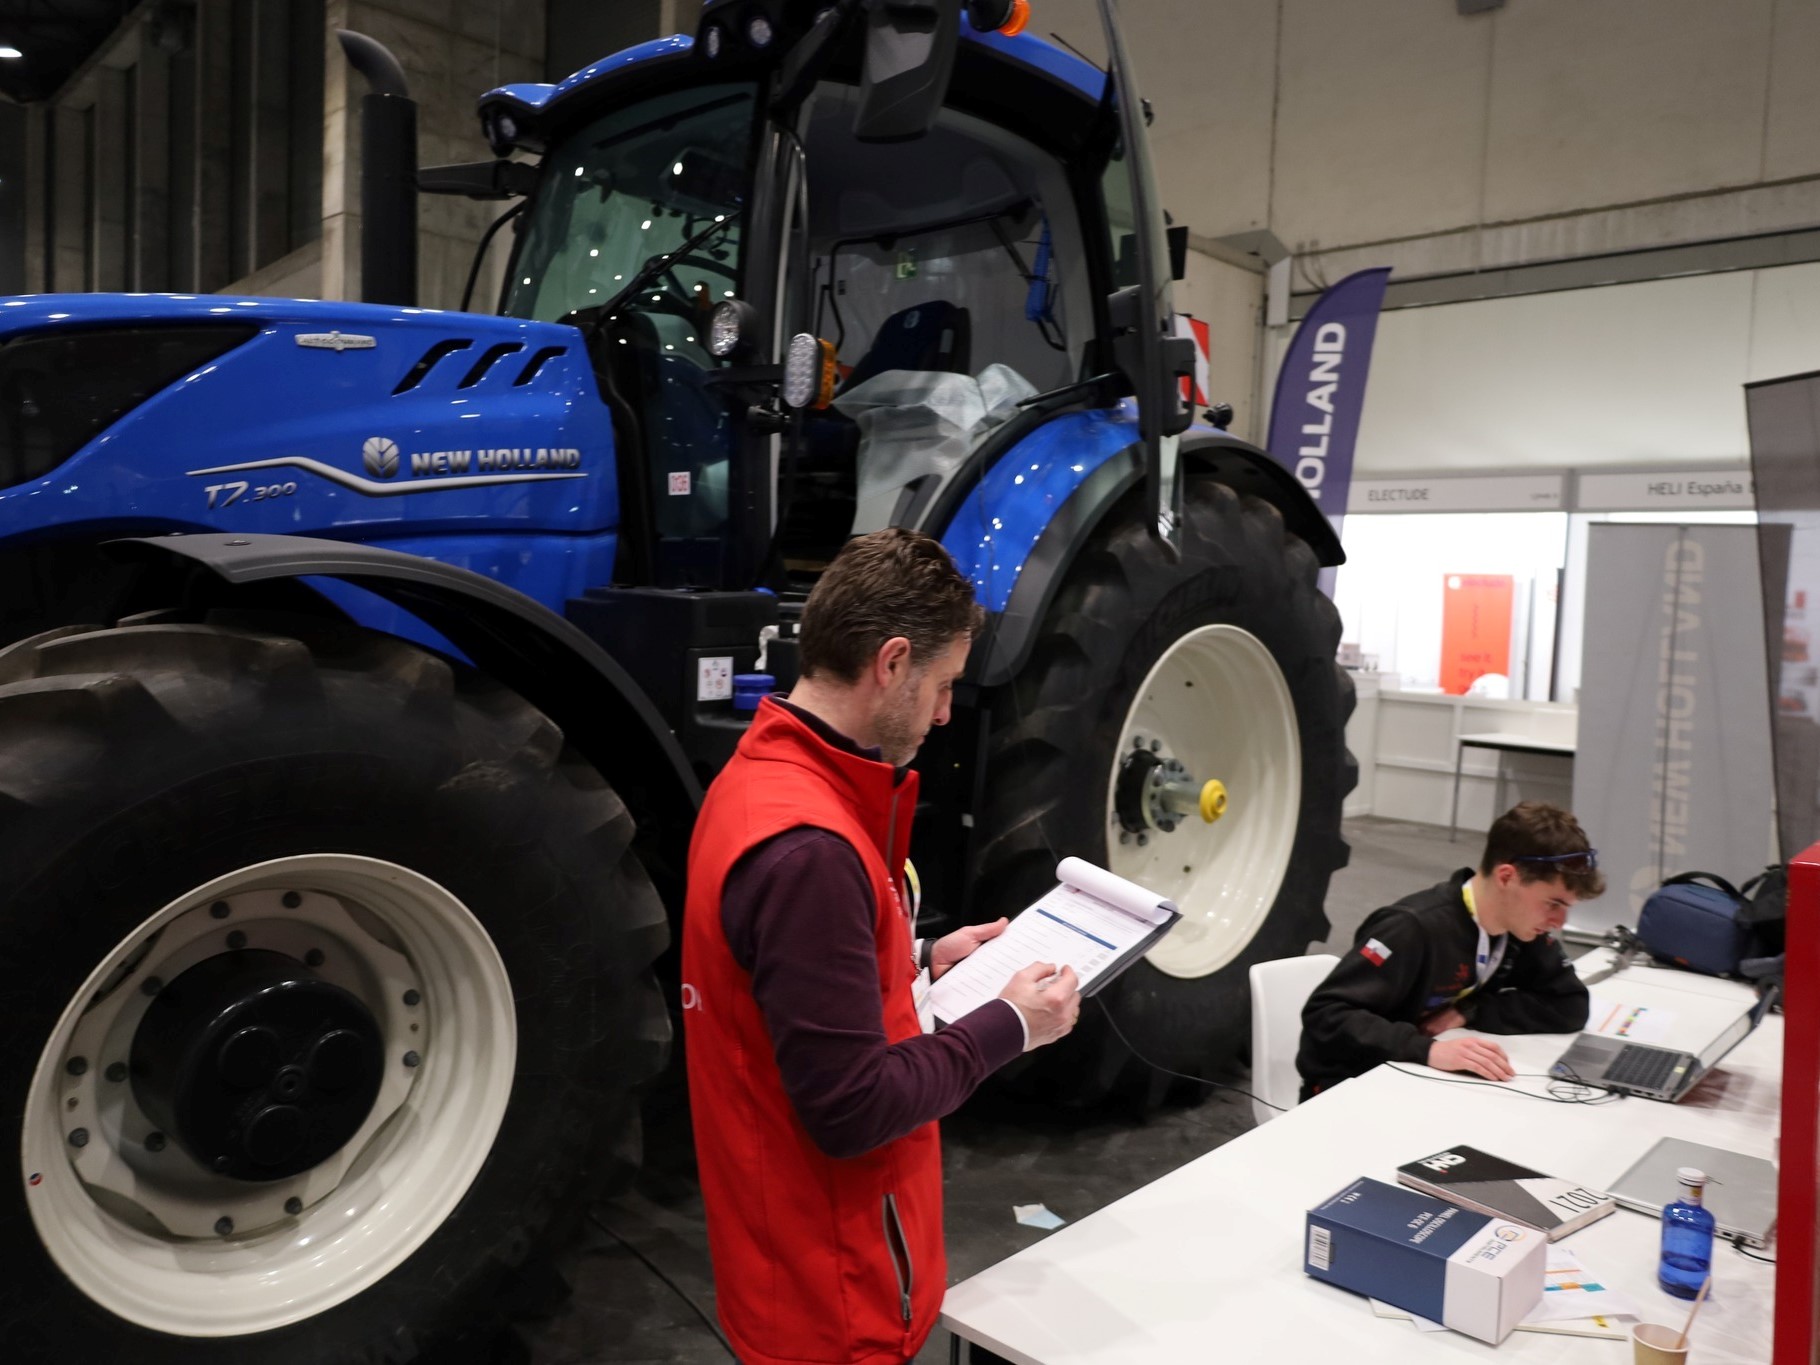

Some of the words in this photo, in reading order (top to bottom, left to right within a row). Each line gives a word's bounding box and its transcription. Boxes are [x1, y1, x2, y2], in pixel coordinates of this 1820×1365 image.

[411, 450, 472, 477] NEW
[477, 448, 581, 472] HOLLAND
[1367, 488, 1430, 501] ELECTUDE
[1687, 480, 1744, 497] España
[1422, 1154, 1467, 1172] CNH
[1549, 1188, 1610, 1213] 2021
[1481, 1239, 1508, 1260] PCE
